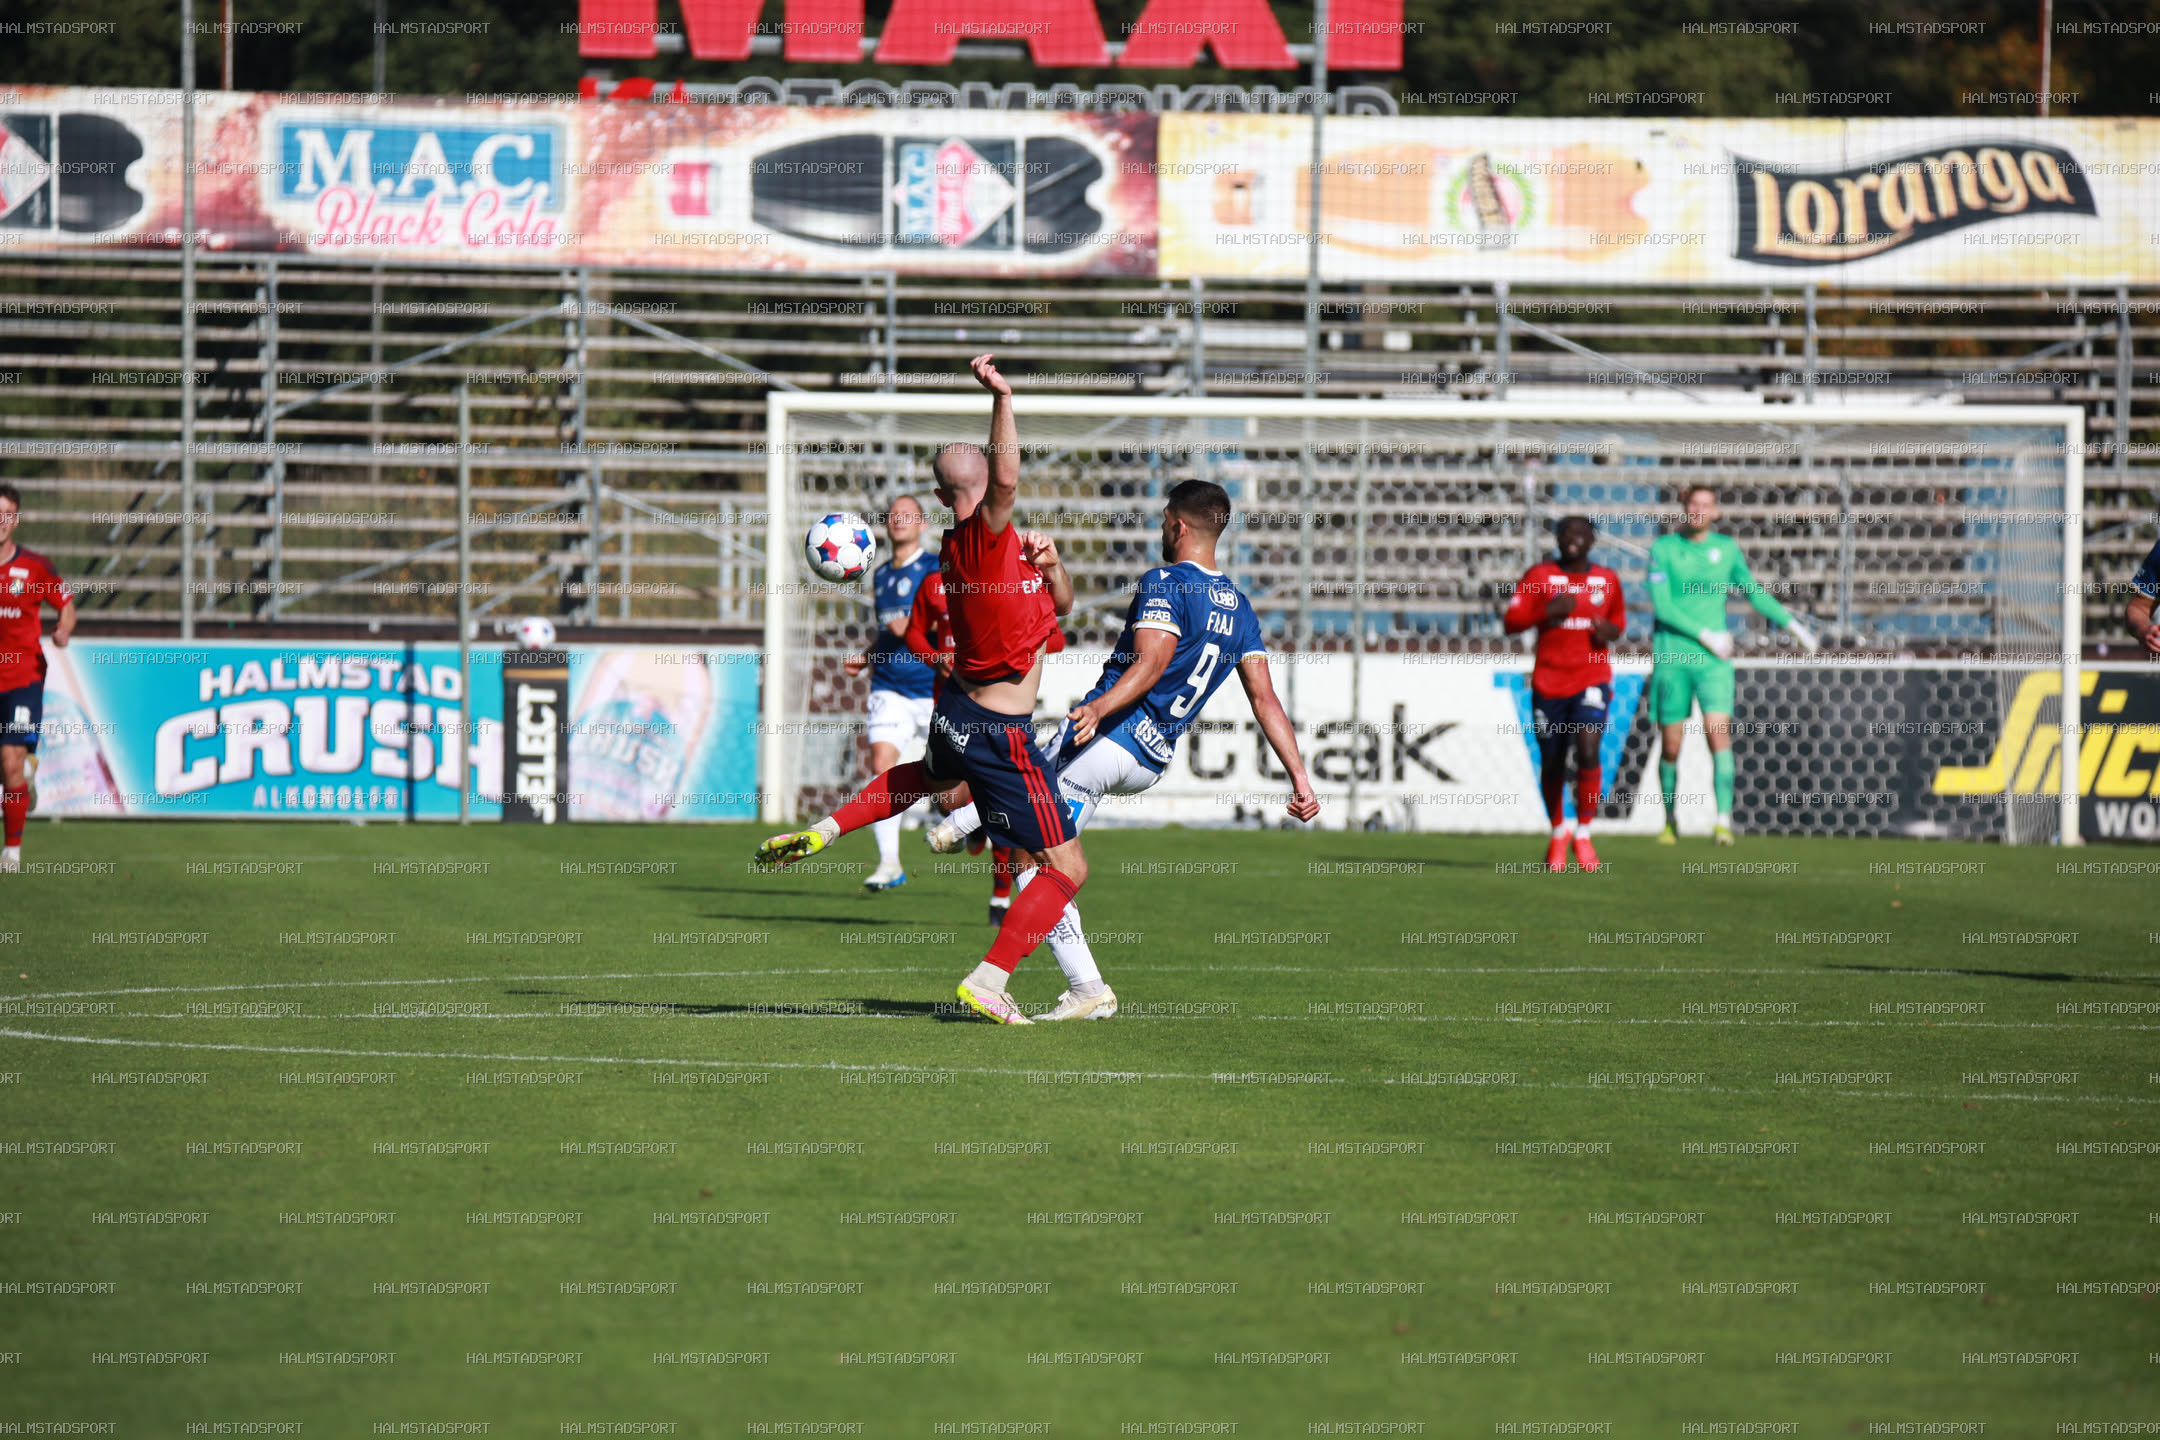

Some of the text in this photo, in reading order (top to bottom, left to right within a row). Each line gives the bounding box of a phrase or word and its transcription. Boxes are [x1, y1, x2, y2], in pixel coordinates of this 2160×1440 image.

[315, 185, 558, 248] Black Cola
[1754, 147, 2076, 259] Loranga
[1142, 609, 1171, 622] HFAB
[200, 656, 463, 702] HALMSTAD
[1169, 642, 1220, 718] 9
[154, 696, 504, 800] CRUSH
[1932, 670, 2160, 797] Snic
[2095, 801, 2160, 838] WO
